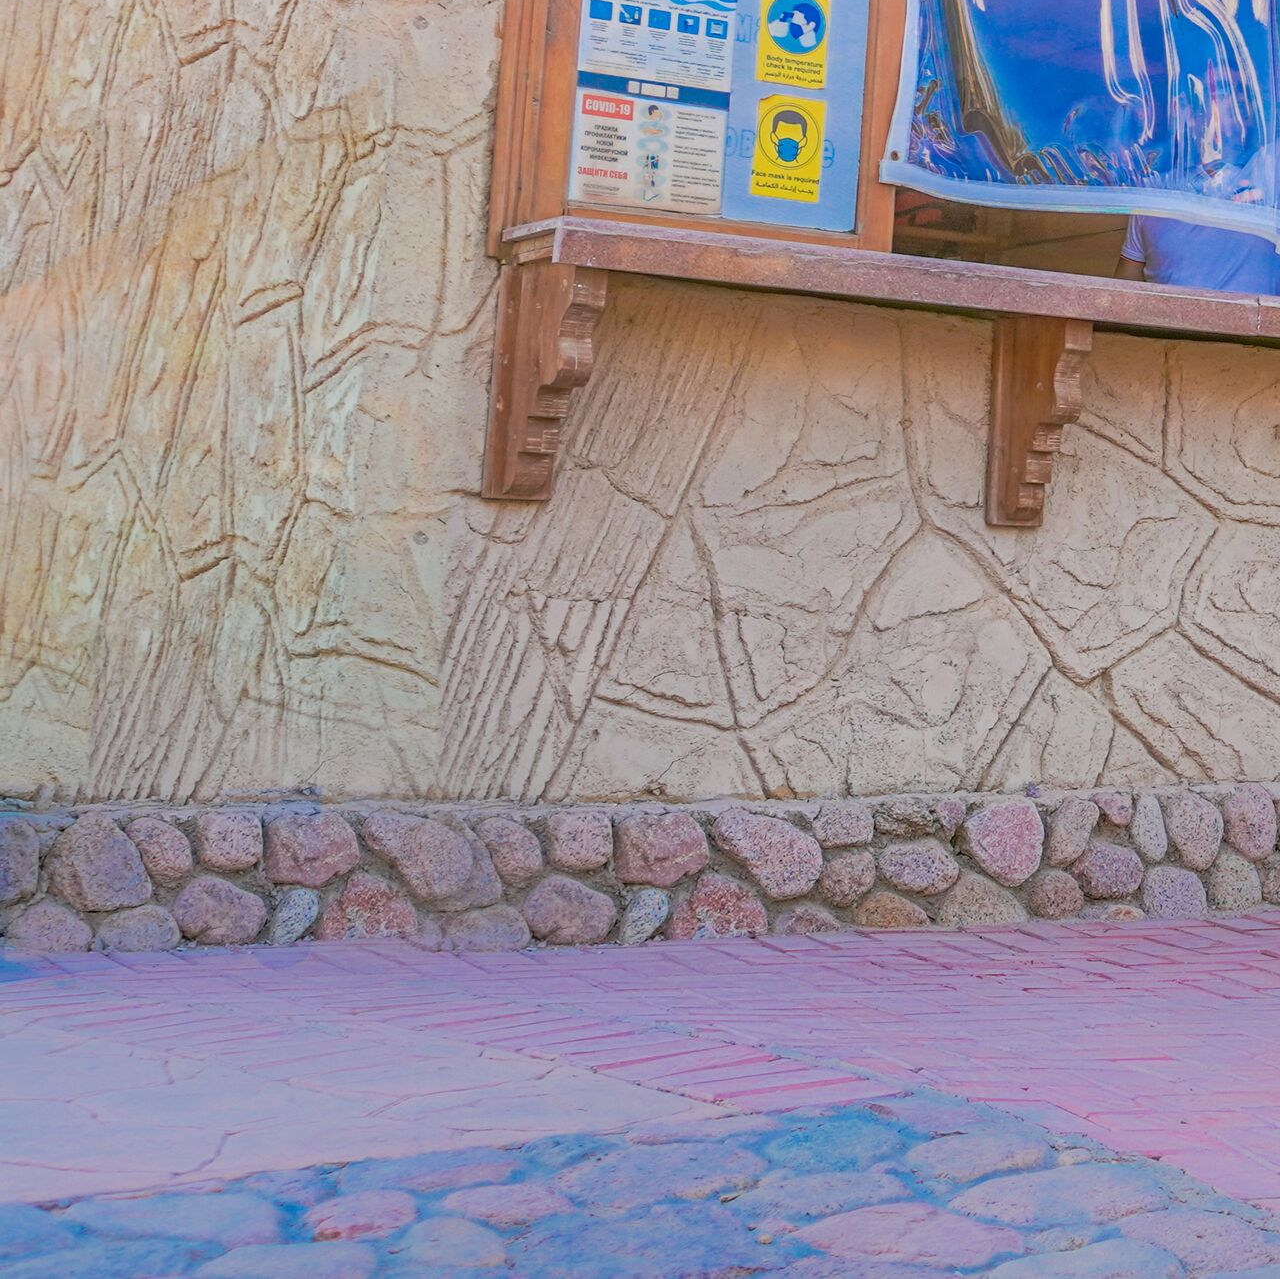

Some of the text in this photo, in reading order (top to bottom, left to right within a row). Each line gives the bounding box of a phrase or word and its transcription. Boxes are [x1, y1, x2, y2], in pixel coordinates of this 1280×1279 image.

[766, 54, 823, 68] Body temperature
[766, 62, 785, 70] check
[794, 66, 821, 75] required
[585, 98, 631, 117] COVID-19
[577, 166, 608, 178] ЗАЩИТИ
[752, 169, 767, 177] Face
[793, 176, 820, 185] required
